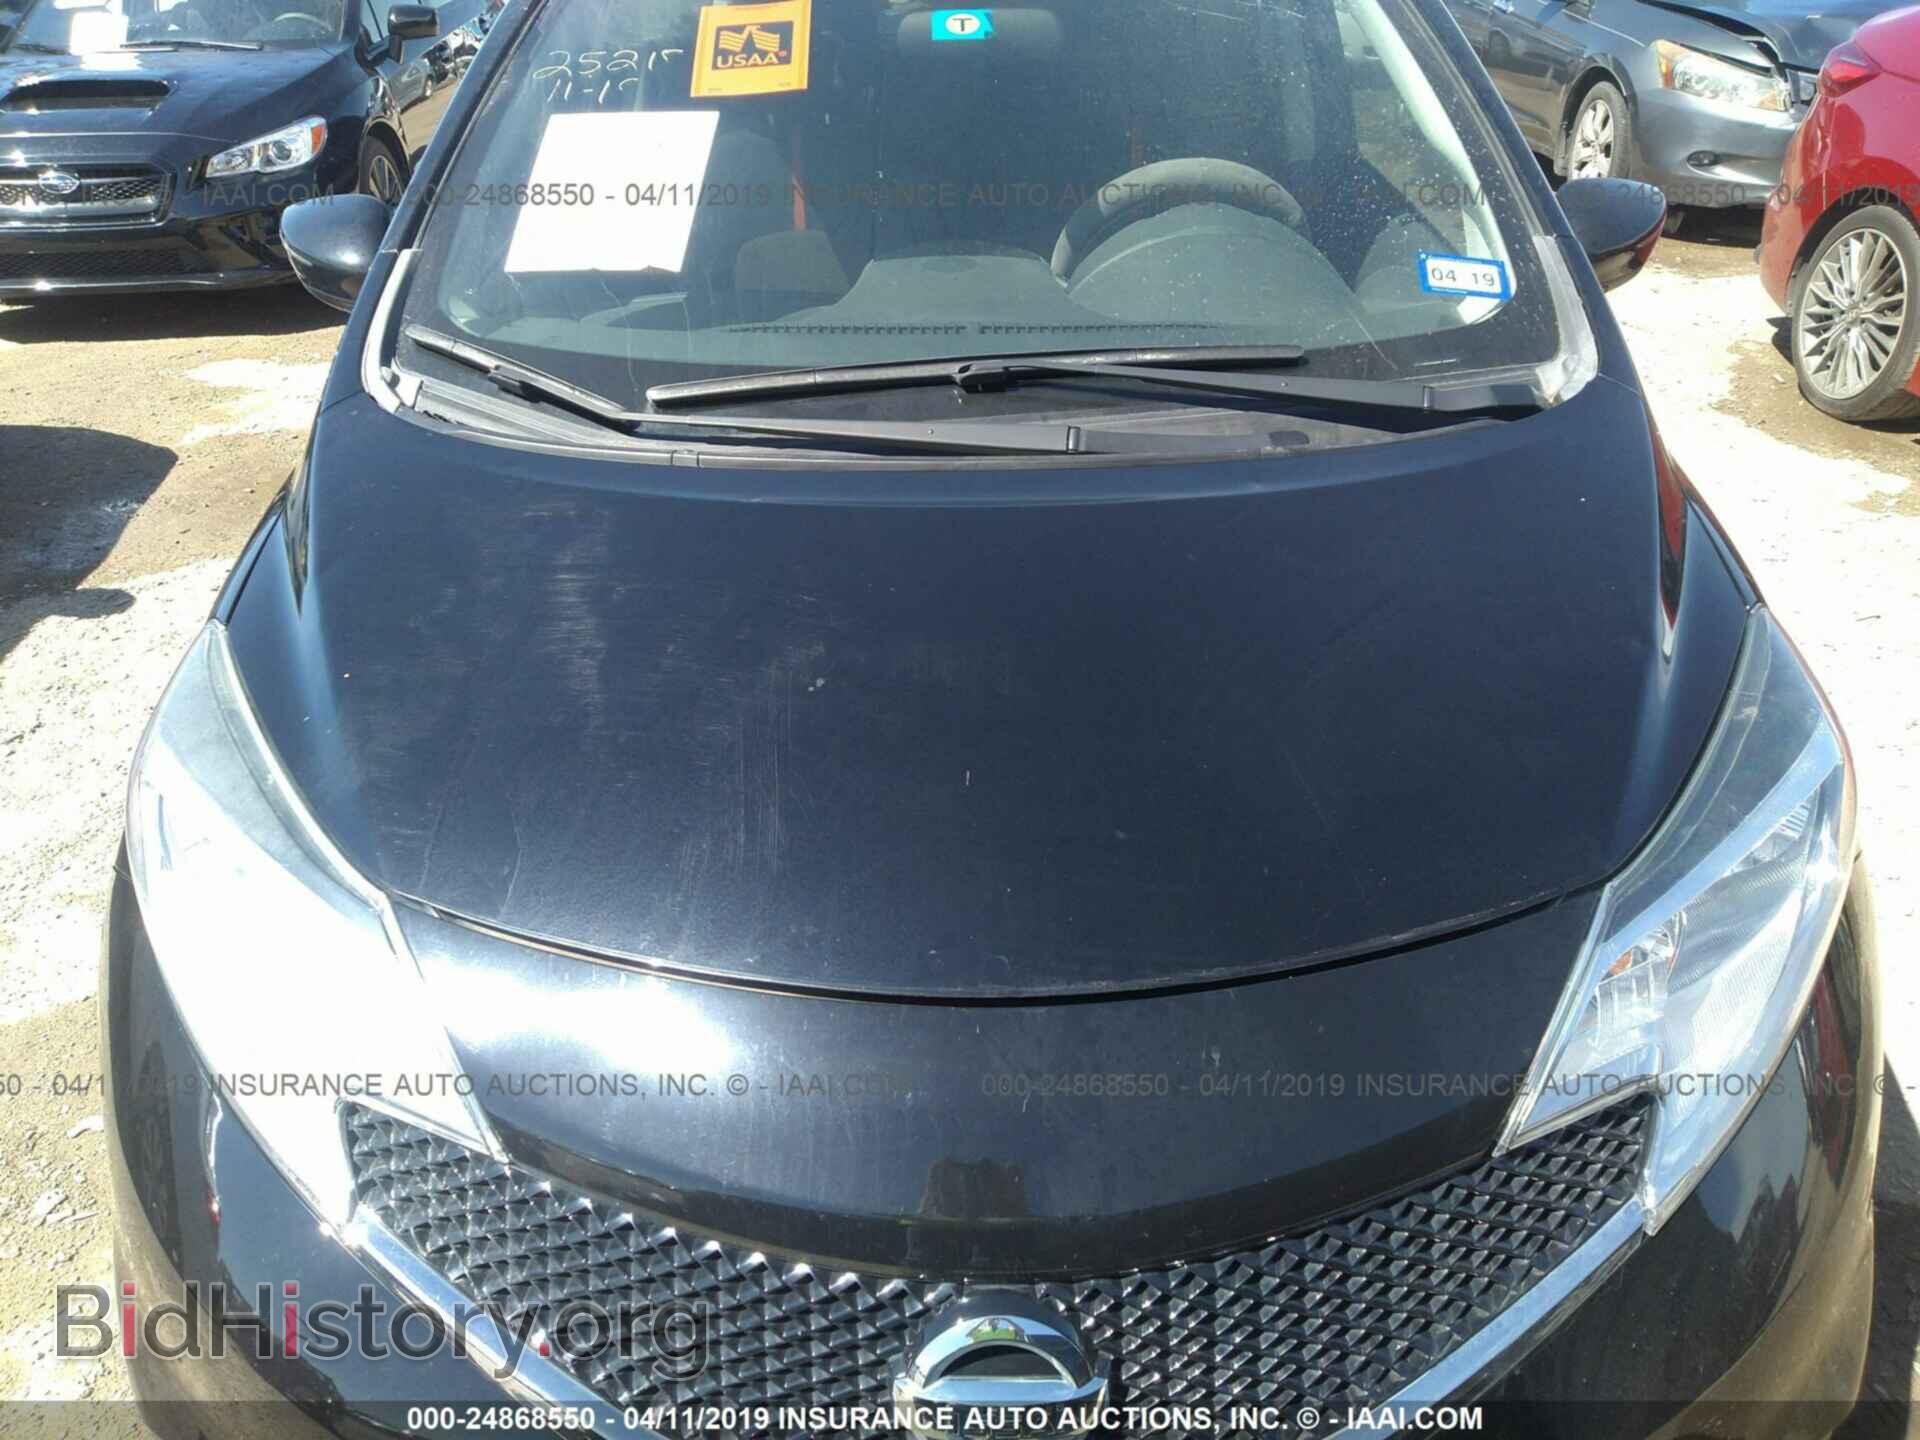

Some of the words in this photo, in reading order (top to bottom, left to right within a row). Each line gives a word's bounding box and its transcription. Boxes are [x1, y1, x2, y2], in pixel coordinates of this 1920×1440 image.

[952, 18, 972, 32] T
[717, 53, 778, 68] USAA
[1431, 267, 1456, 281] 04
[1472, 272, 1494, 287] 19
